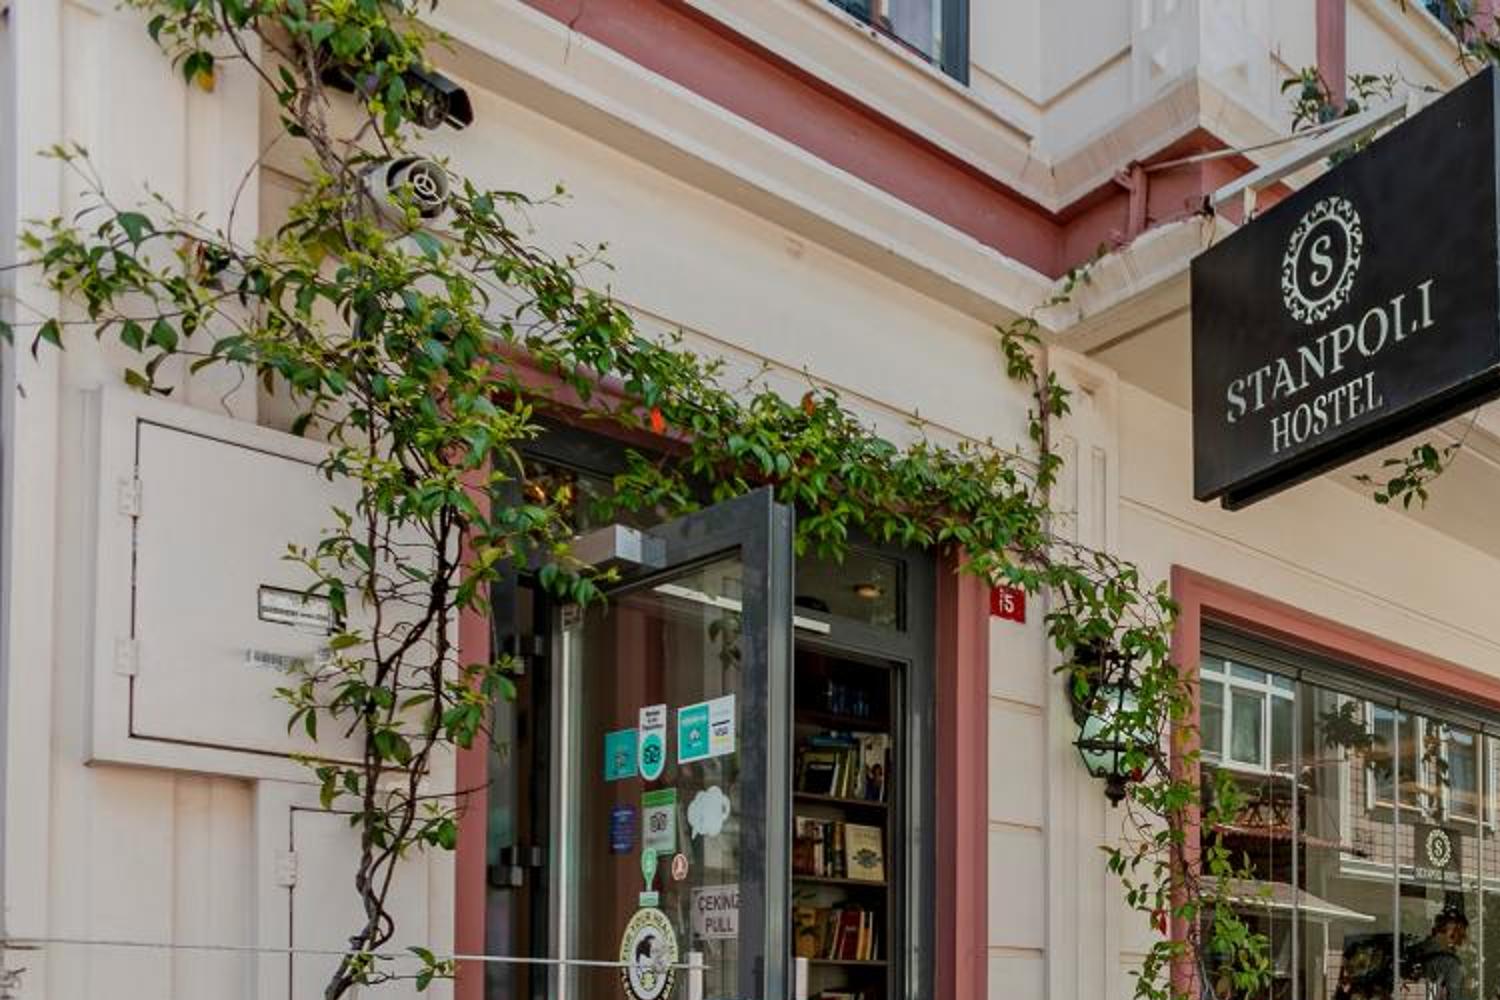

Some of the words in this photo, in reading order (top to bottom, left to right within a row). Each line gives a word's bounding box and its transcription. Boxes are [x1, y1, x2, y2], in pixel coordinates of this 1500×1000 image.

[1310, 235, 1333, 287] S
[1226, 279, 1437, 424] STANPOLI
[1271, 372, 1384, 454] HOSTEL
[705, 917, 735, 933] PULL
